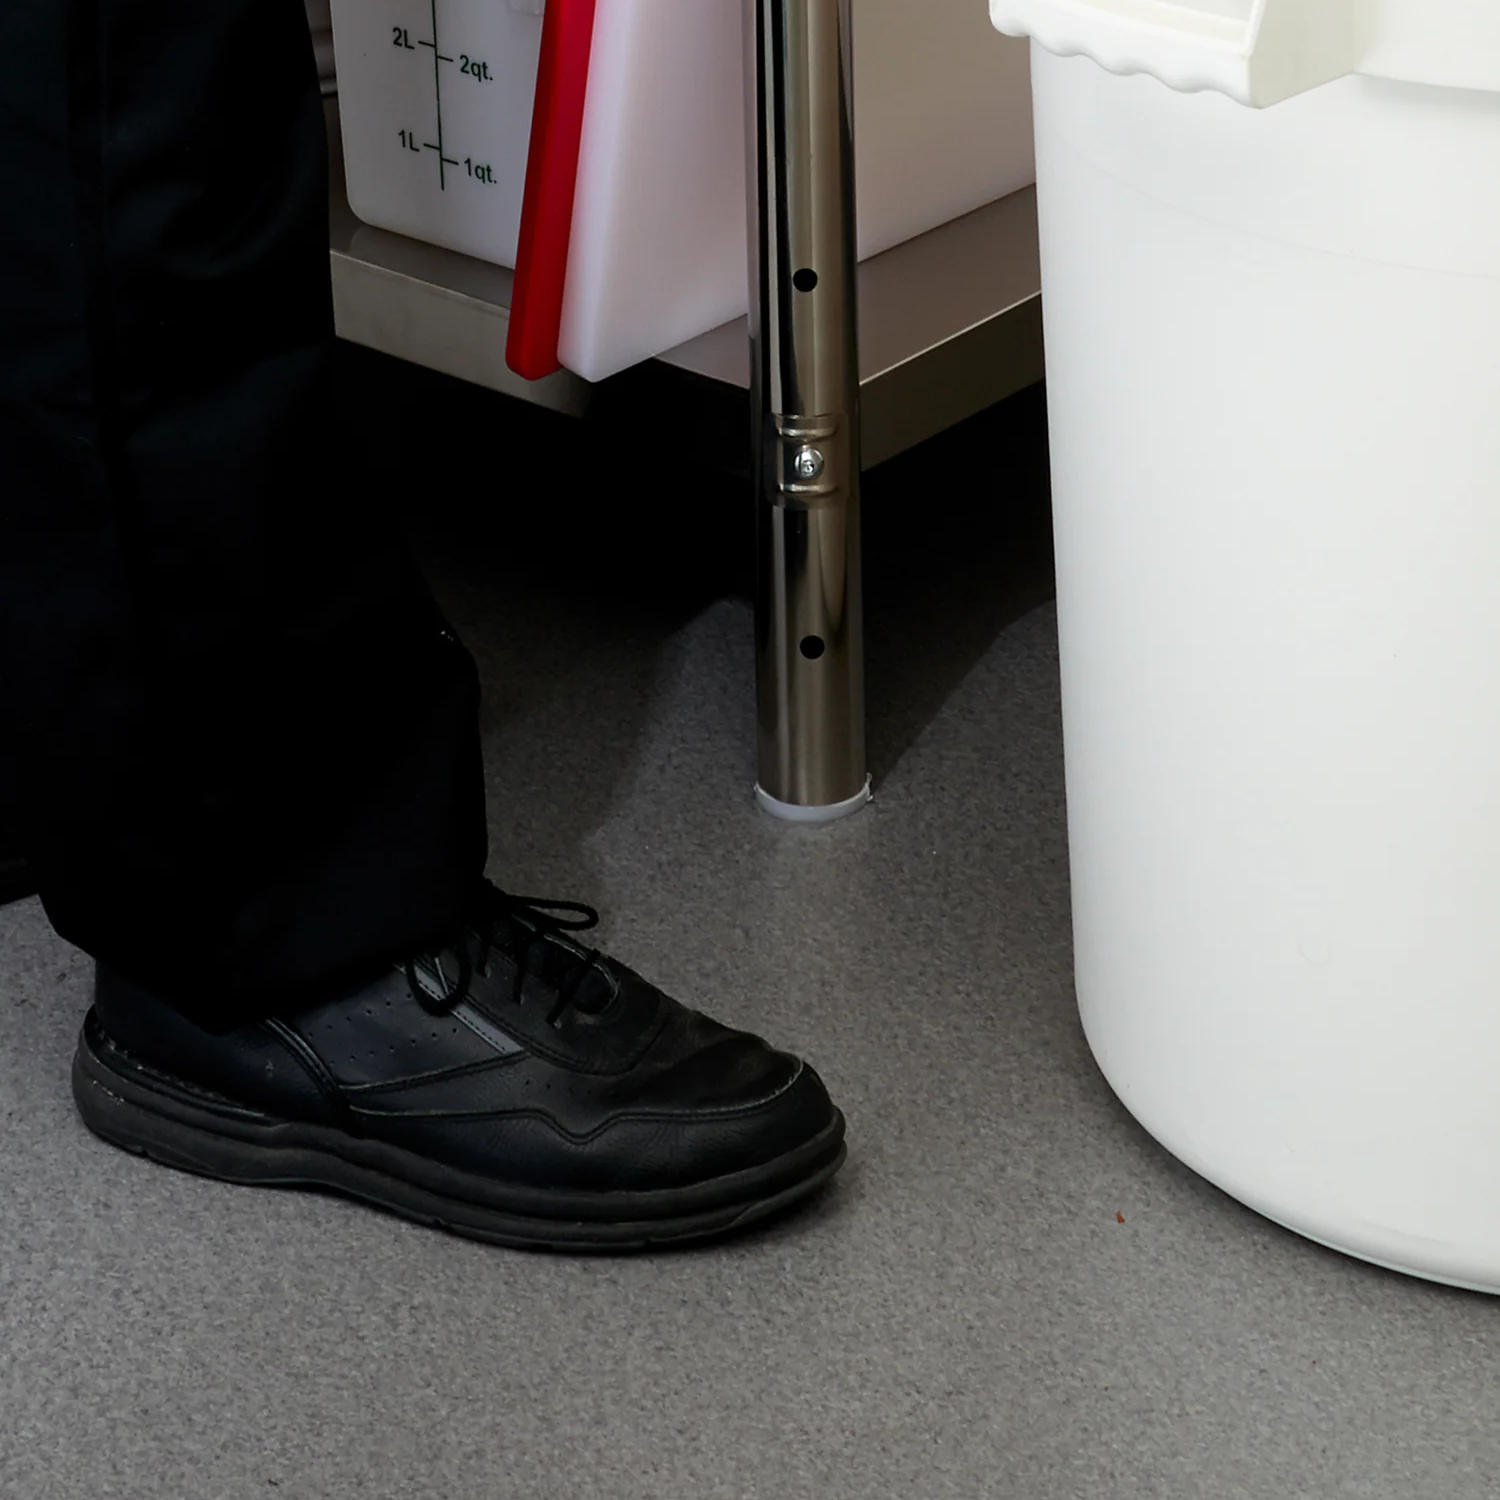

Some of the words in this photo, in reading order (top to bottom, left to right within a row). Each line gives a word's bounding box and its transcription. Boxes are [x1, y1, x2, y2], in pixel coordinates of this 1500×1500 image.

[393, 27, 415, 49] 2L
[459, 55, 493, 82] 2qt.
[398, 130, 420, 152] 1L
[464, 158, 497, 184] 1qt.
